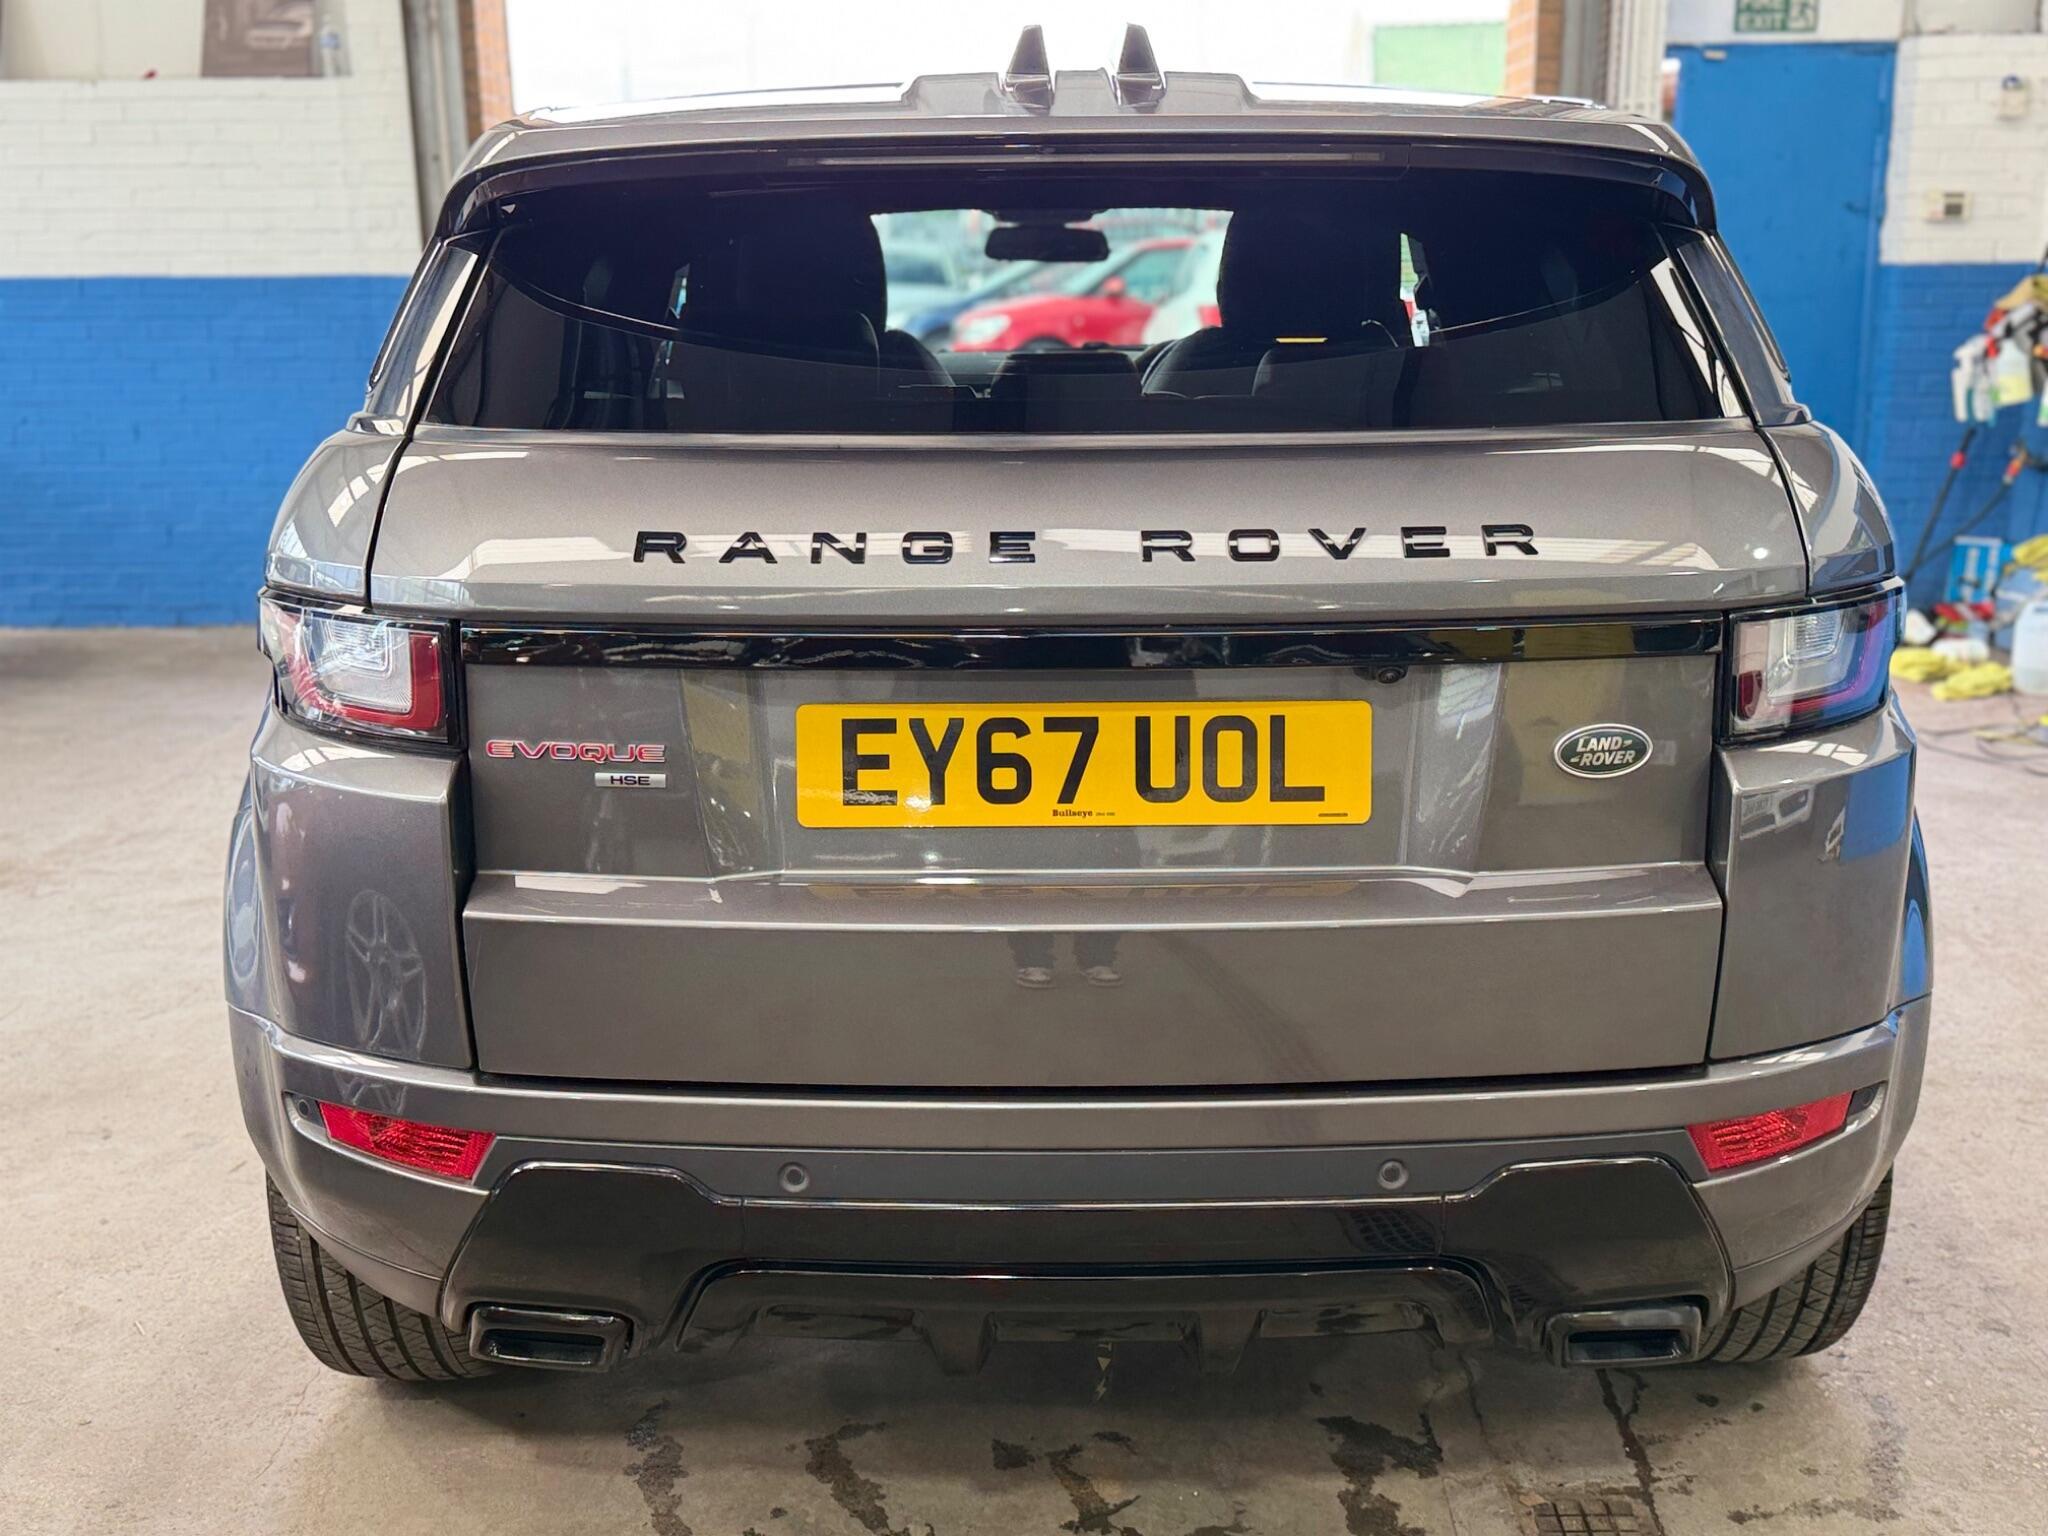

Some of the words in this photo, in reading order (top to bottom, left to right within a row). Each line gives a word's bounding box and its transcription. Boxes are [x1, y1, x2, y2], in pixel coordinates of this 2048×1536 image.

[633, 531, 1036, 564] RANGE
[1141, 524, 1539, 562] ROVER
[486, 739, 665, 764] EVOQUE
[842, 717, 1099, 806] EY67
[1136, 715, 1325, 804] UOL
[610, 775, 651, 786] HSE
[1052, 809, 1093, 818] Bullseye
